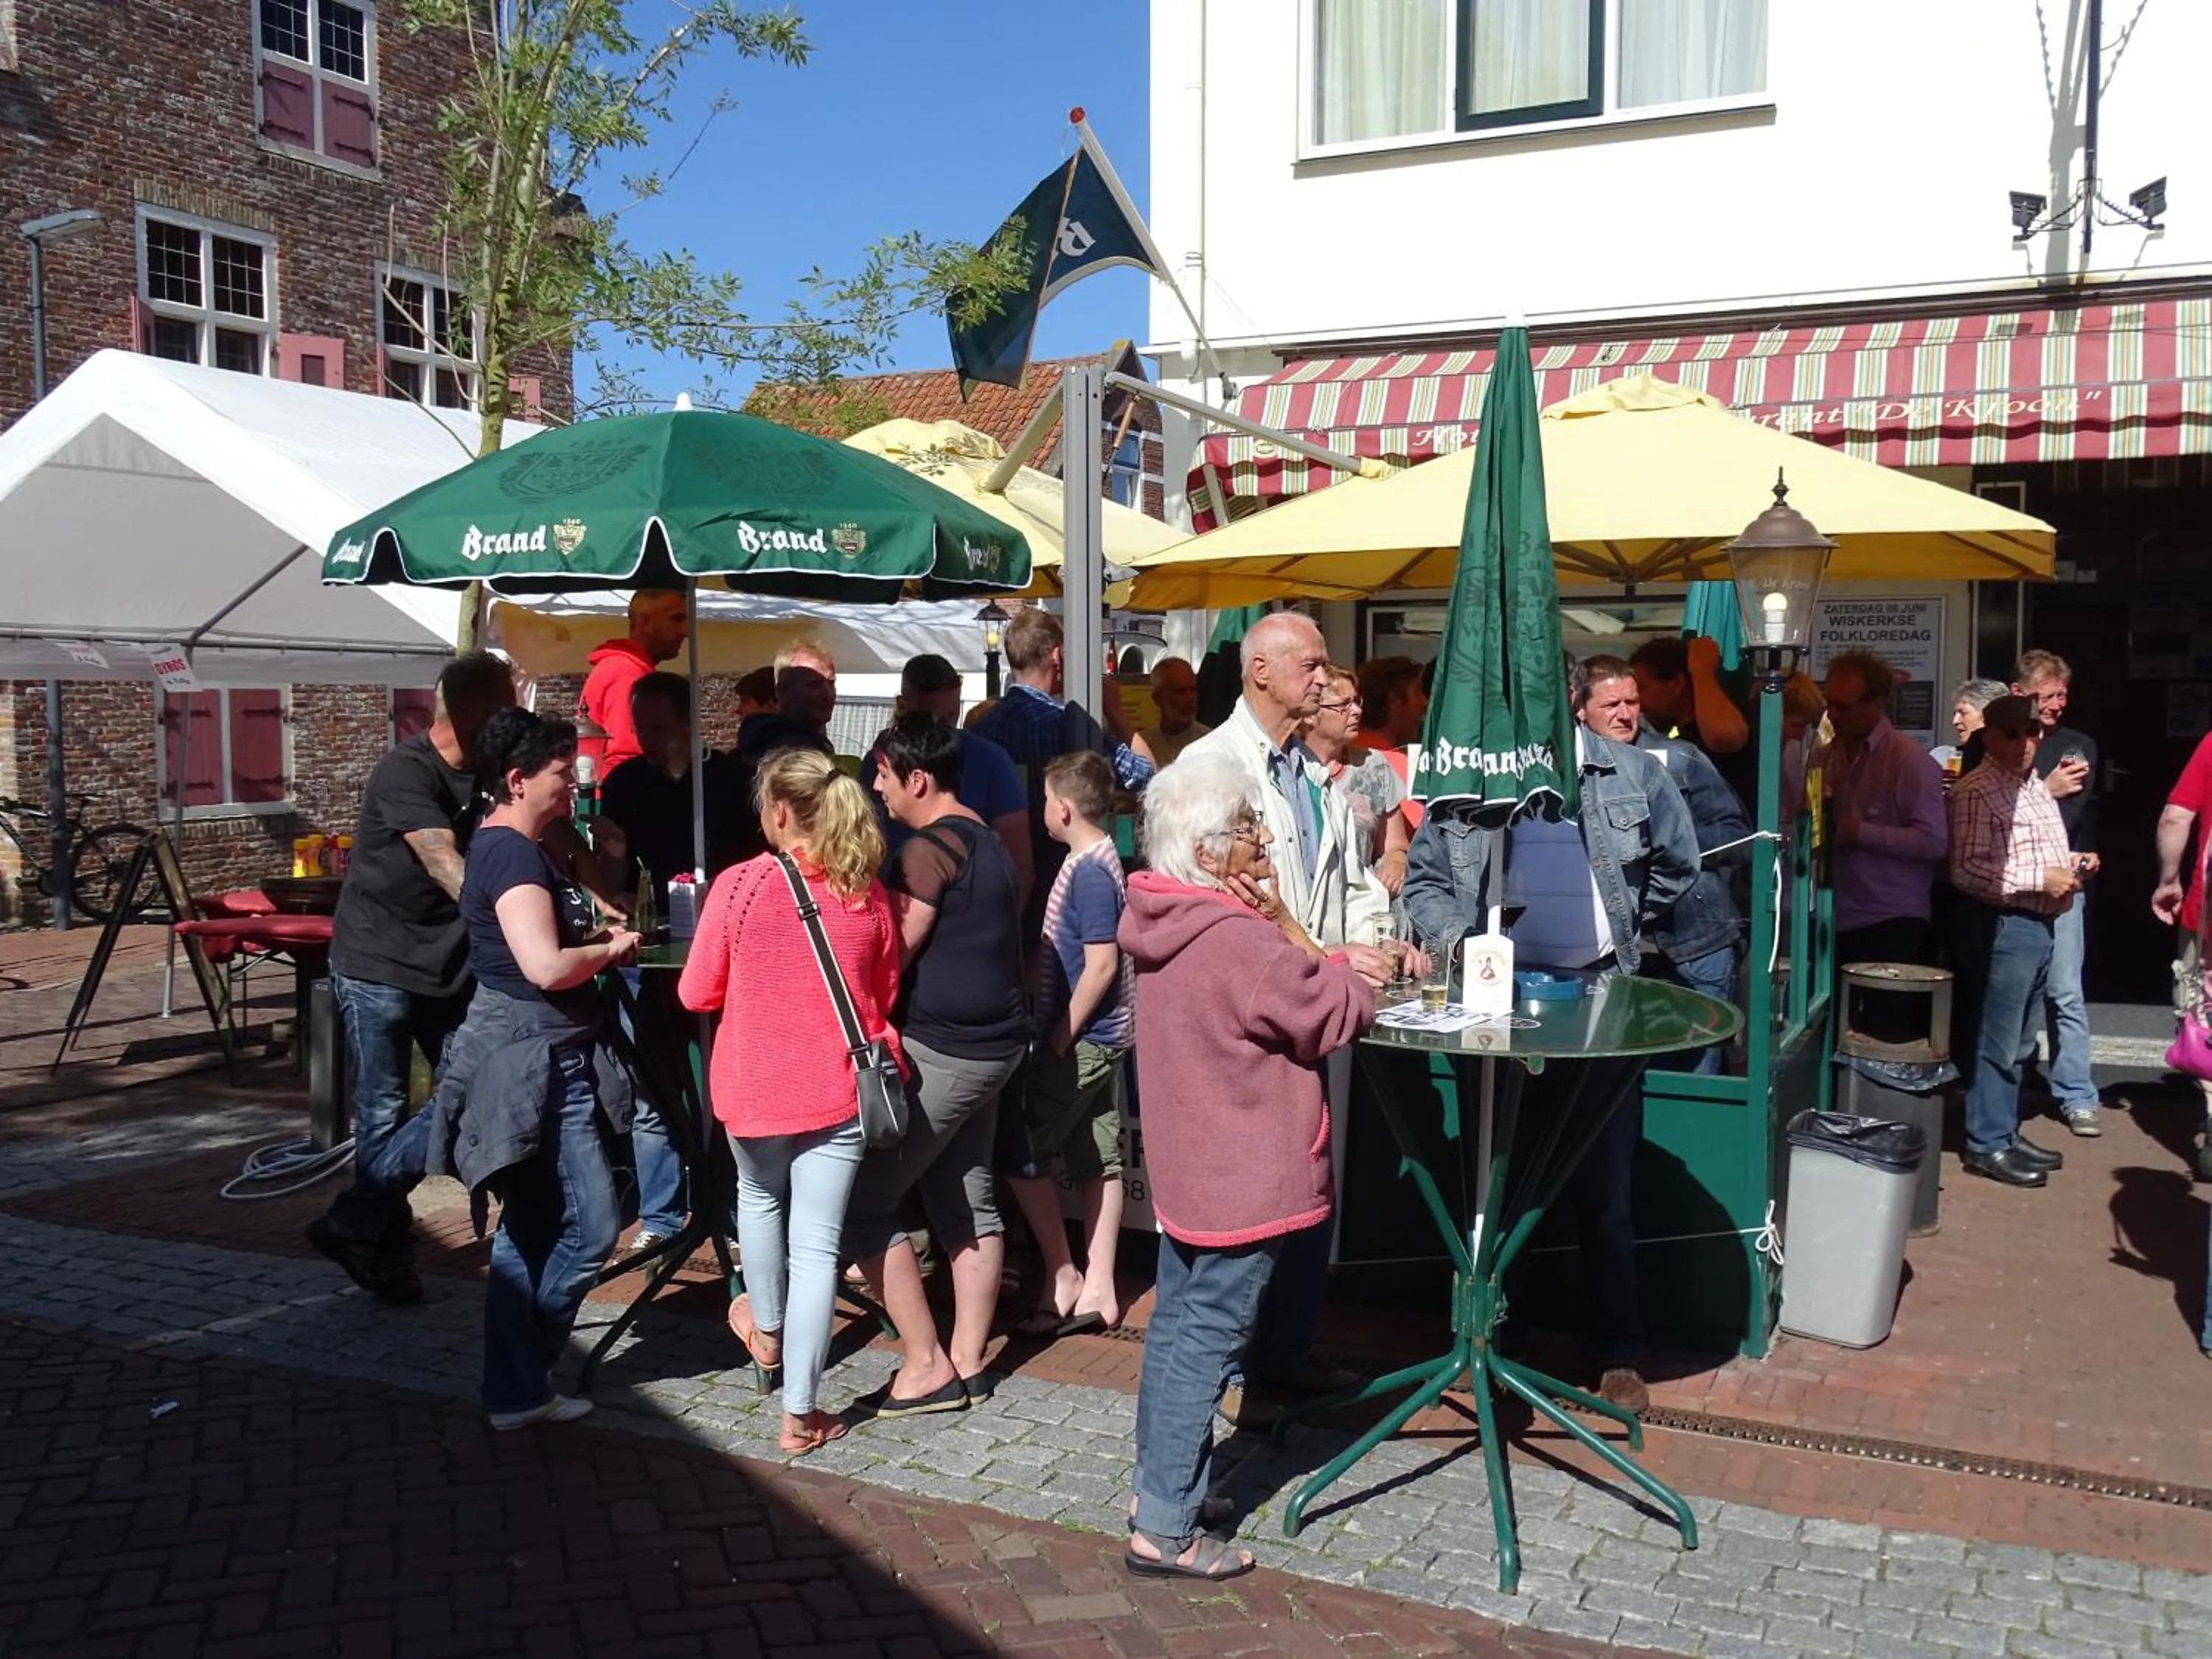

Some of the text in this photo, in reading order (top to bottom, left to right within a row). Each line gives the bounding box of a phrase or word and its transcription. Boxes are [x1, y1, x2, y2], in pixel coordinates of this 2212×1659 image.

[462, 524, 546, 561] Brand
[737, 520, 828, 554] Brand
[1829, 614, 1917, 627] WISKERKSE
[1820, 630, 1931, 642] FOLKLOREDAG
